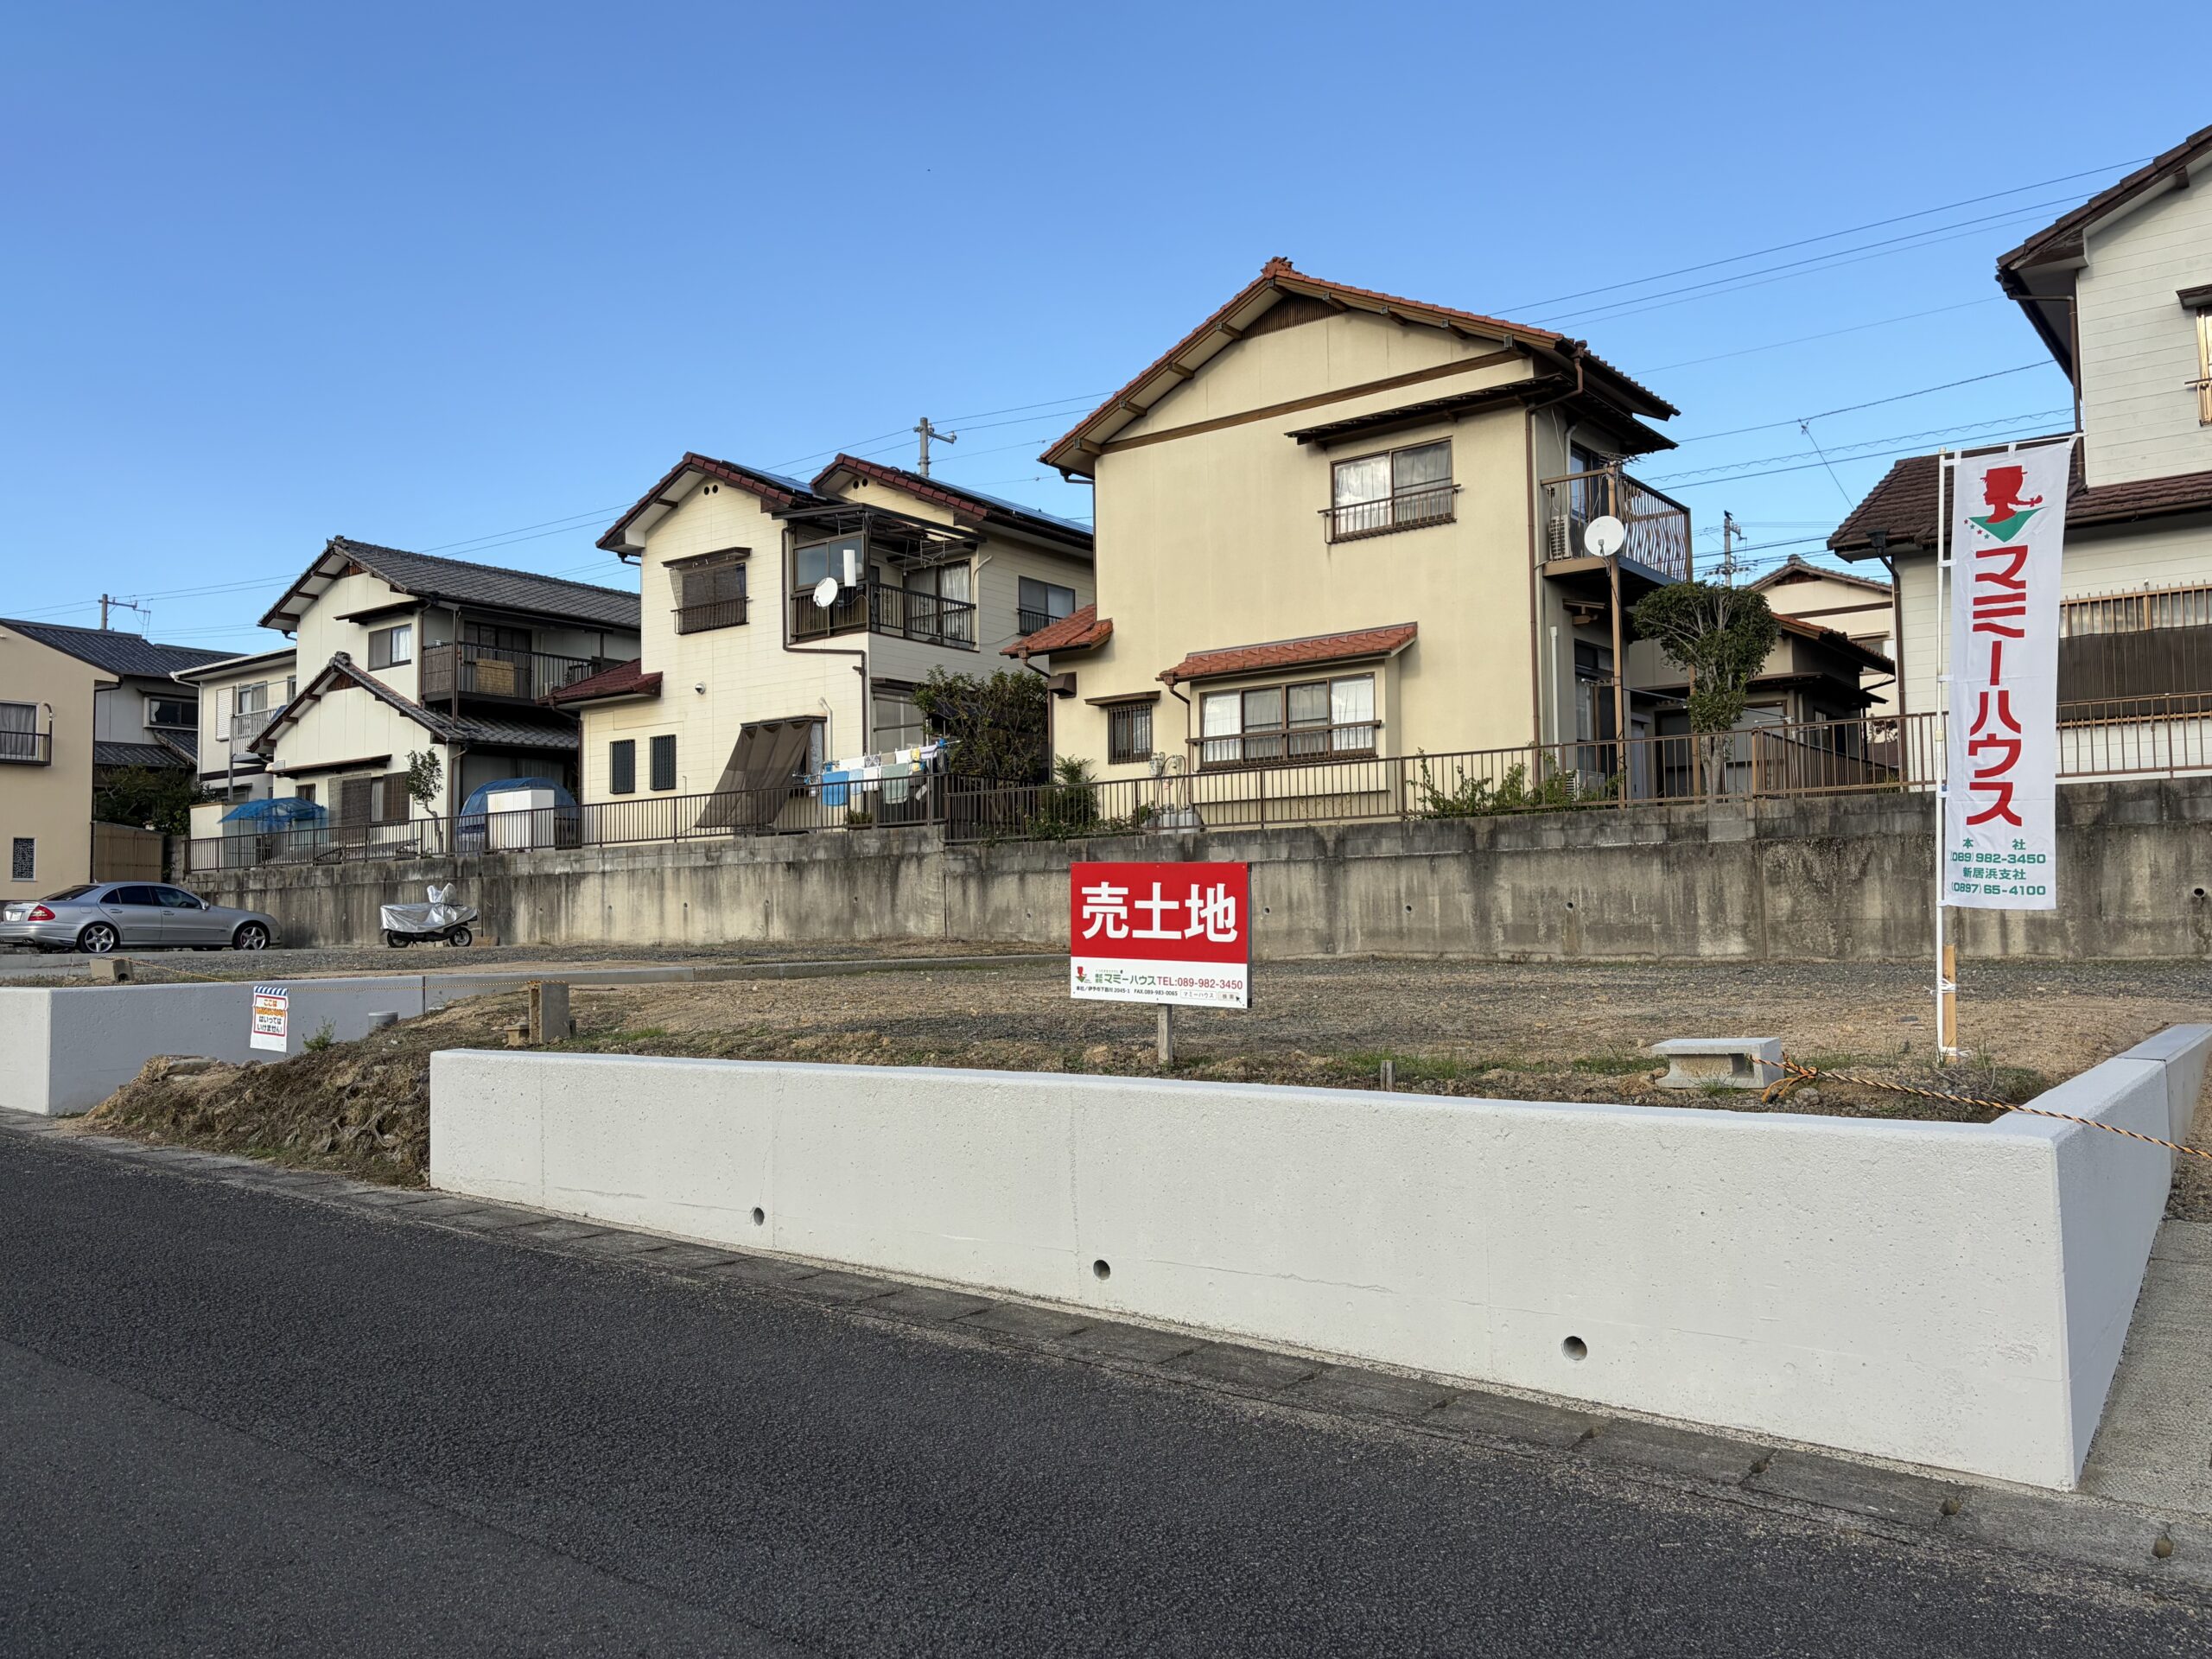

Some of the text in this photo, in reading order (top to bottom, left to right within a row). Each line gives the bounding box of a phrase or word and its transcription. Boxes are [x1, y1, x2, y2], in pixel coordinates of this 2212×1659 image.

[1966, 544, 2029, 827] マミーハウス
[1962, 867, 2026, 880] 新居浜支社
[1081, 881, 1238, 943] 売土地
